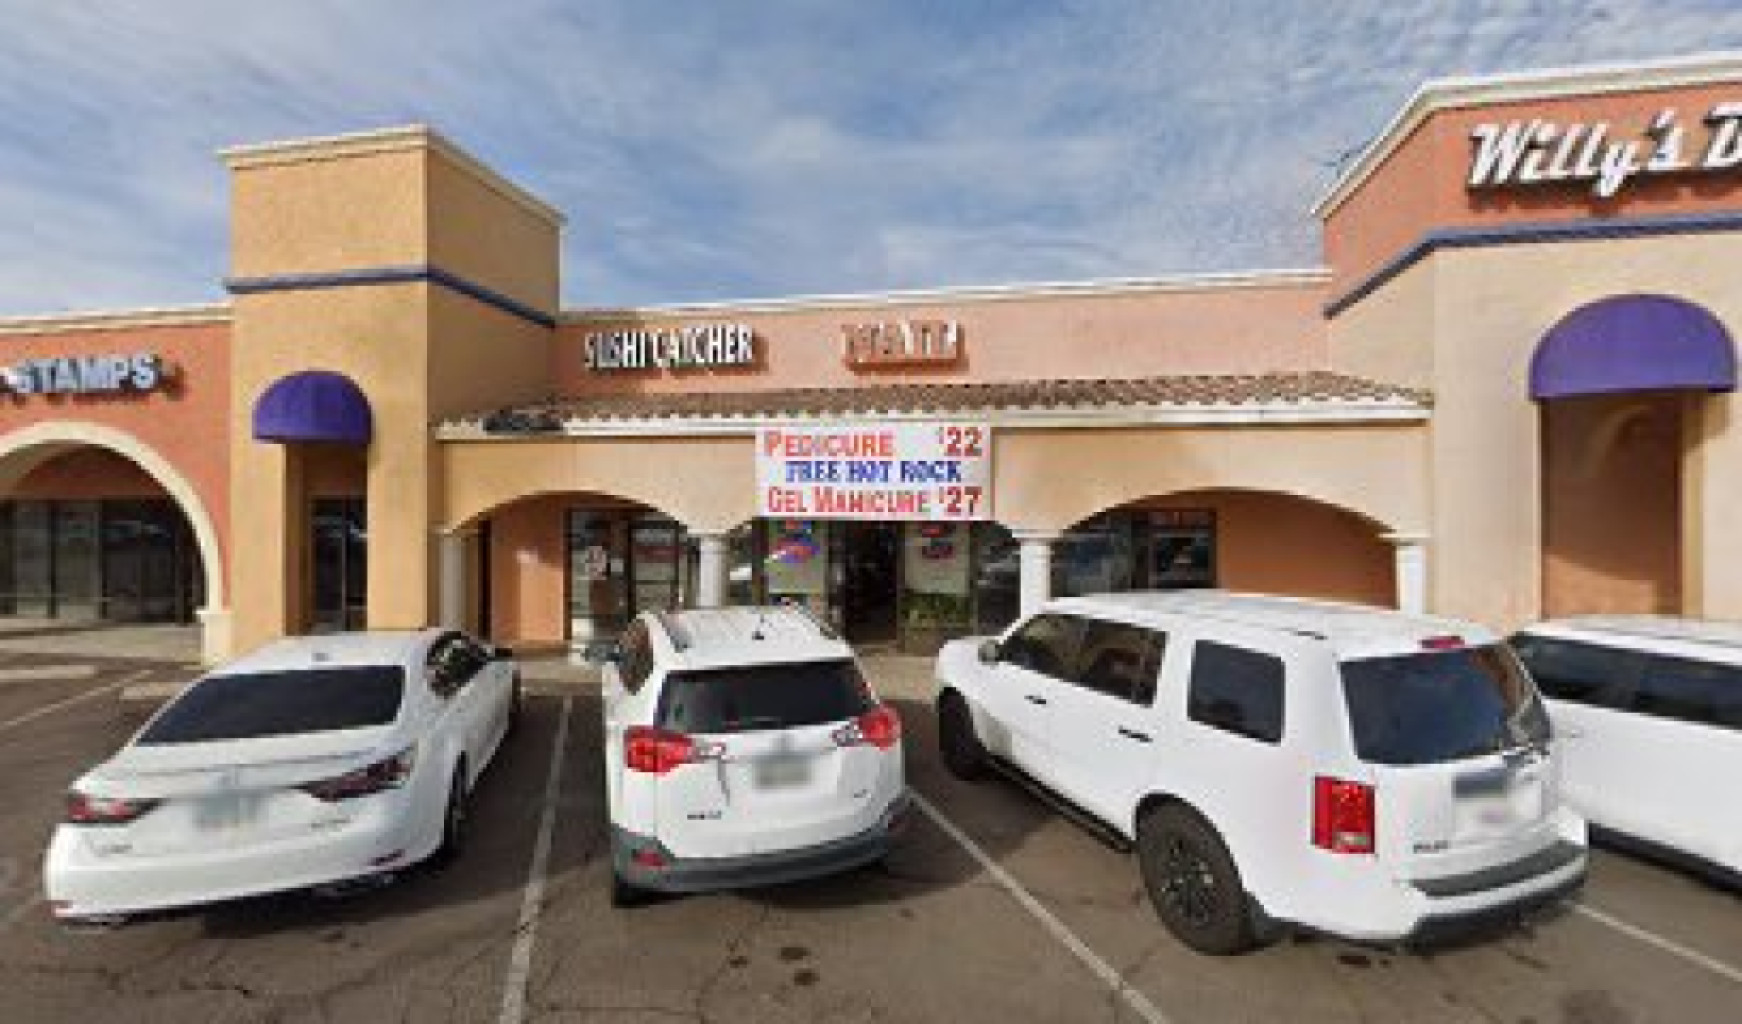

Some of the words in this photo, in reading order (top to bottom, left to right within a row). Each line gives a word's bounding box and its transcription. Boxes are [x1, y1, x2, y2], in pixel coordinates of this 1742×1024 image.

[1469, 109, 1691, 197] Willy's
[652, 324, 753, 367] CATCHER
[15, 353, 158, 393] STAMPS
[764, 431, 893, 457] PEDICURE
[785, 460, 837, 482] FREE
[845, 460, 892, 482] HOT
[900, 460, 961, 482] ROCK
[768, 486, 806, 513] GEL
[813, 486, 930, 513] MANICURE
